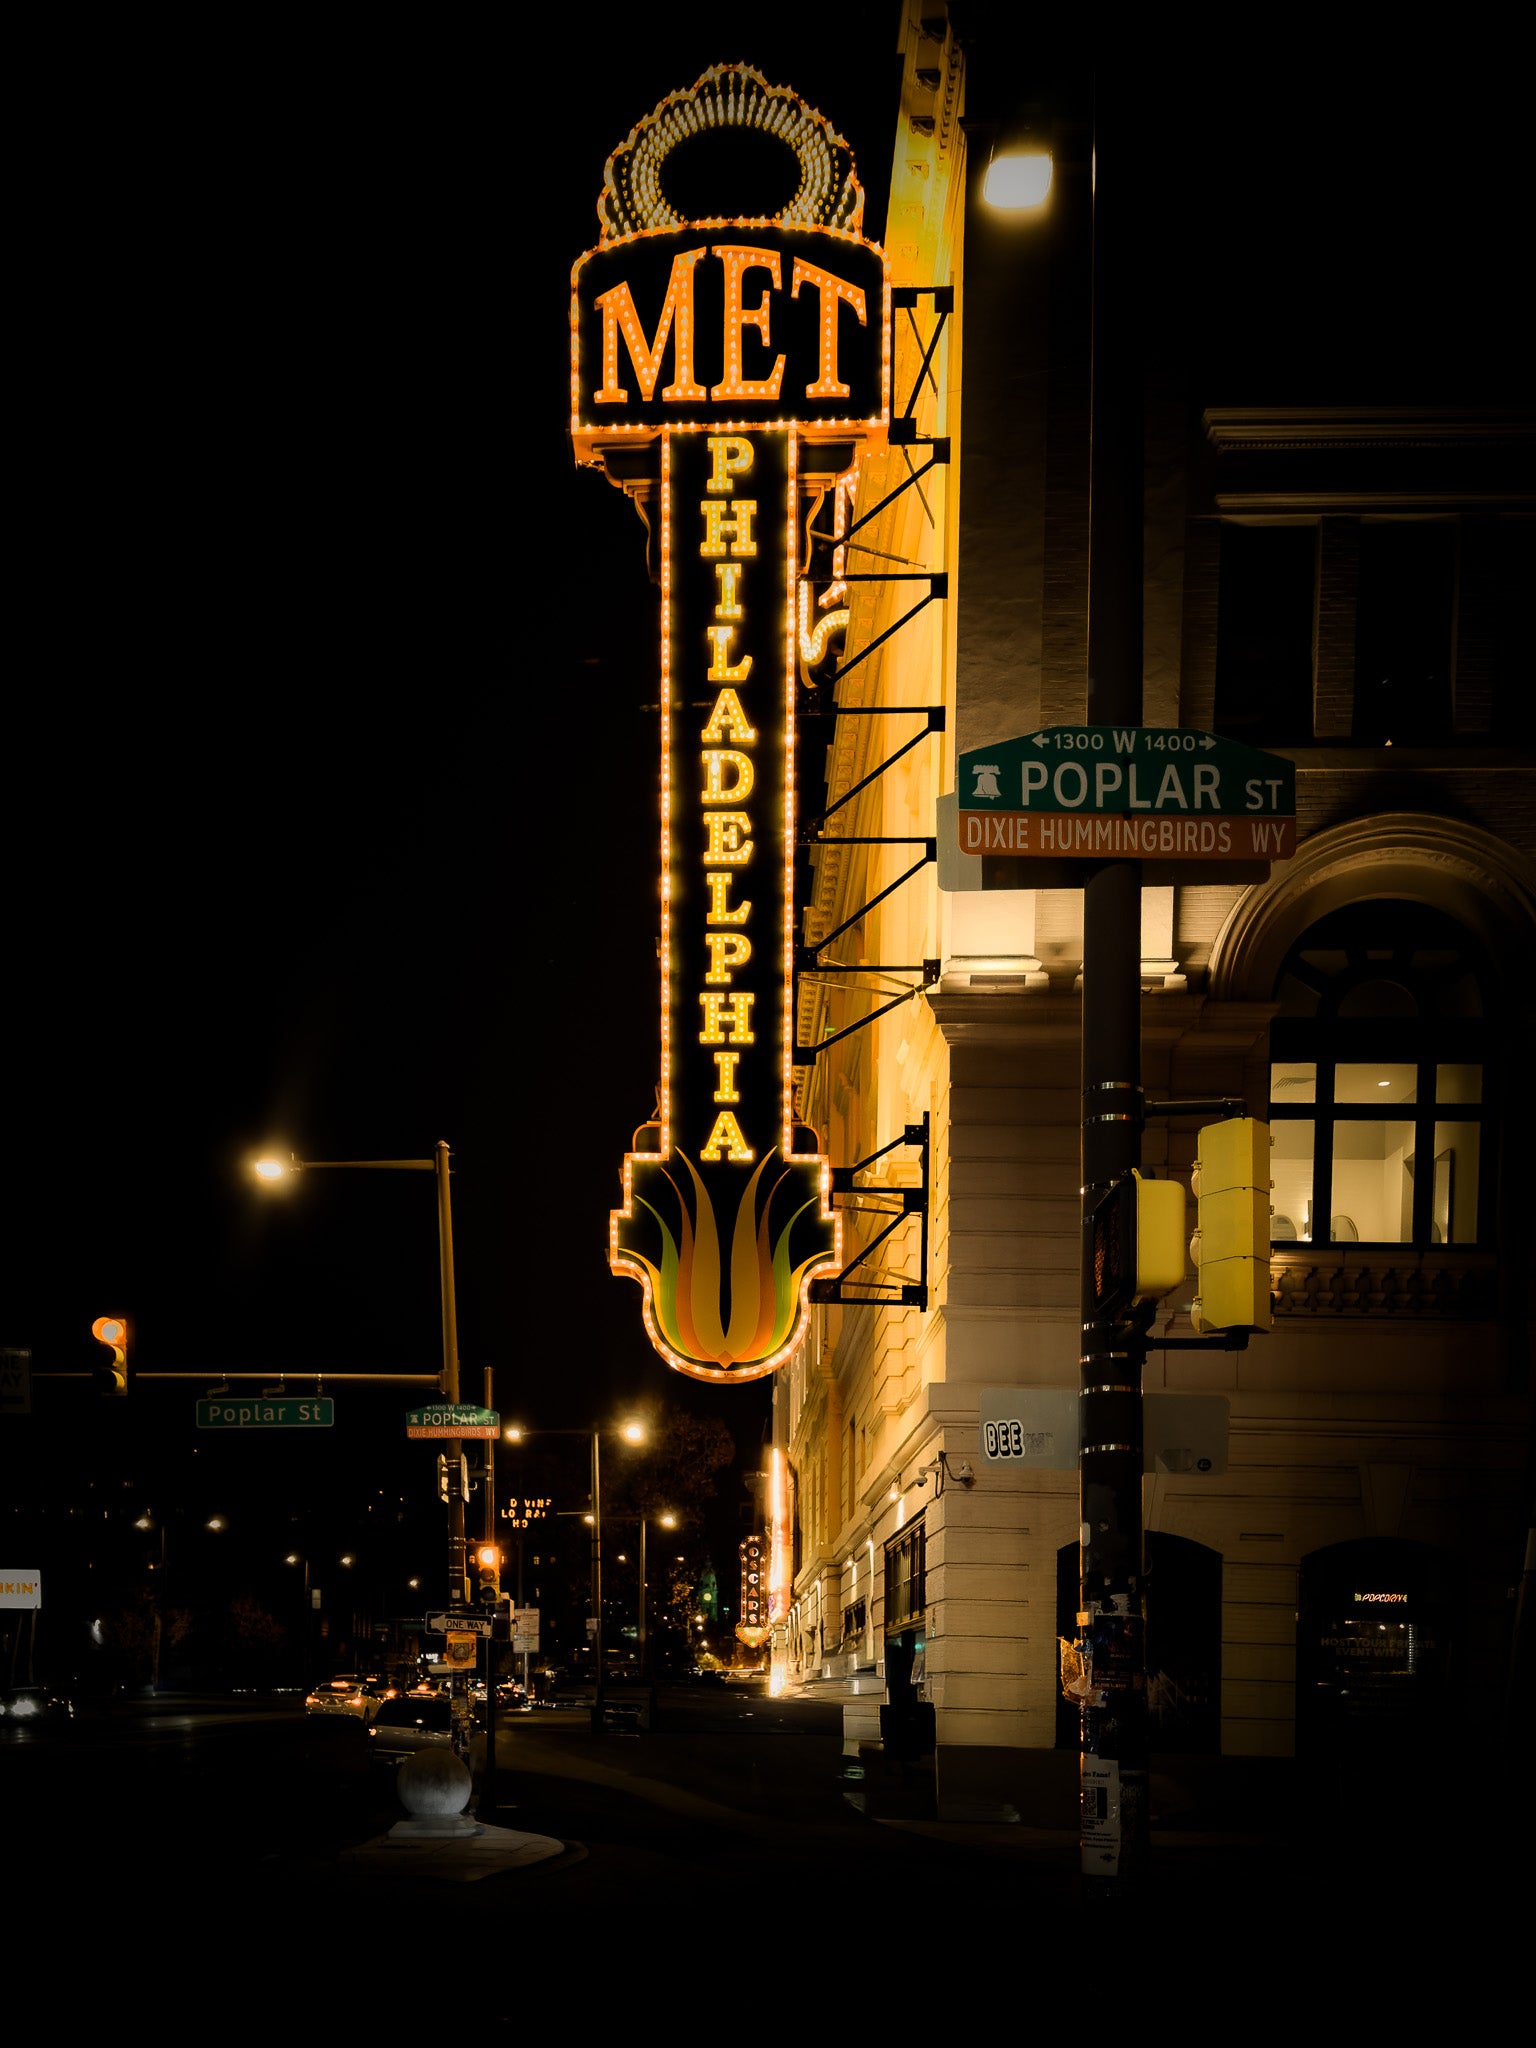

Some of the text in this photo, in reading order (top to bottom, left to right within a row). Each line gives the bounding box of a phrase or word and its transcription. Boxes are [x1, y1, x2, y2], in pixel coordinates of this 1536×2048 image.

[594, 245, 867, 403] MET
[1054, 730, 1196, 754] 1300 W 1400
[1021, 761, 1284, 810] POPLAR ST
[699, 437, 757, 1161] PHILADELPHIA
[967, 816, 1287, 853] DIXIE HUMMINGBIRDS WY
[208, 1404, 321, 1426] Poplar St
[423, 1412, 495, 1426] POPLAR ST
[408, 1428, 496, 1437] DIXIE HUMMINGBIRDS WY
[984, 1421, 1023, 1457] BEE
[1362, 1592, 1403, 1603] POPCORN
[446, 1619, 486, 1630] ONE WAY
[1320, 1637, 1437, 1649] HOST YOUR PRIATE
[1336, 1647, 1372, 1657] EVENT
[1373, 1648, 1405, 1657] WITH
